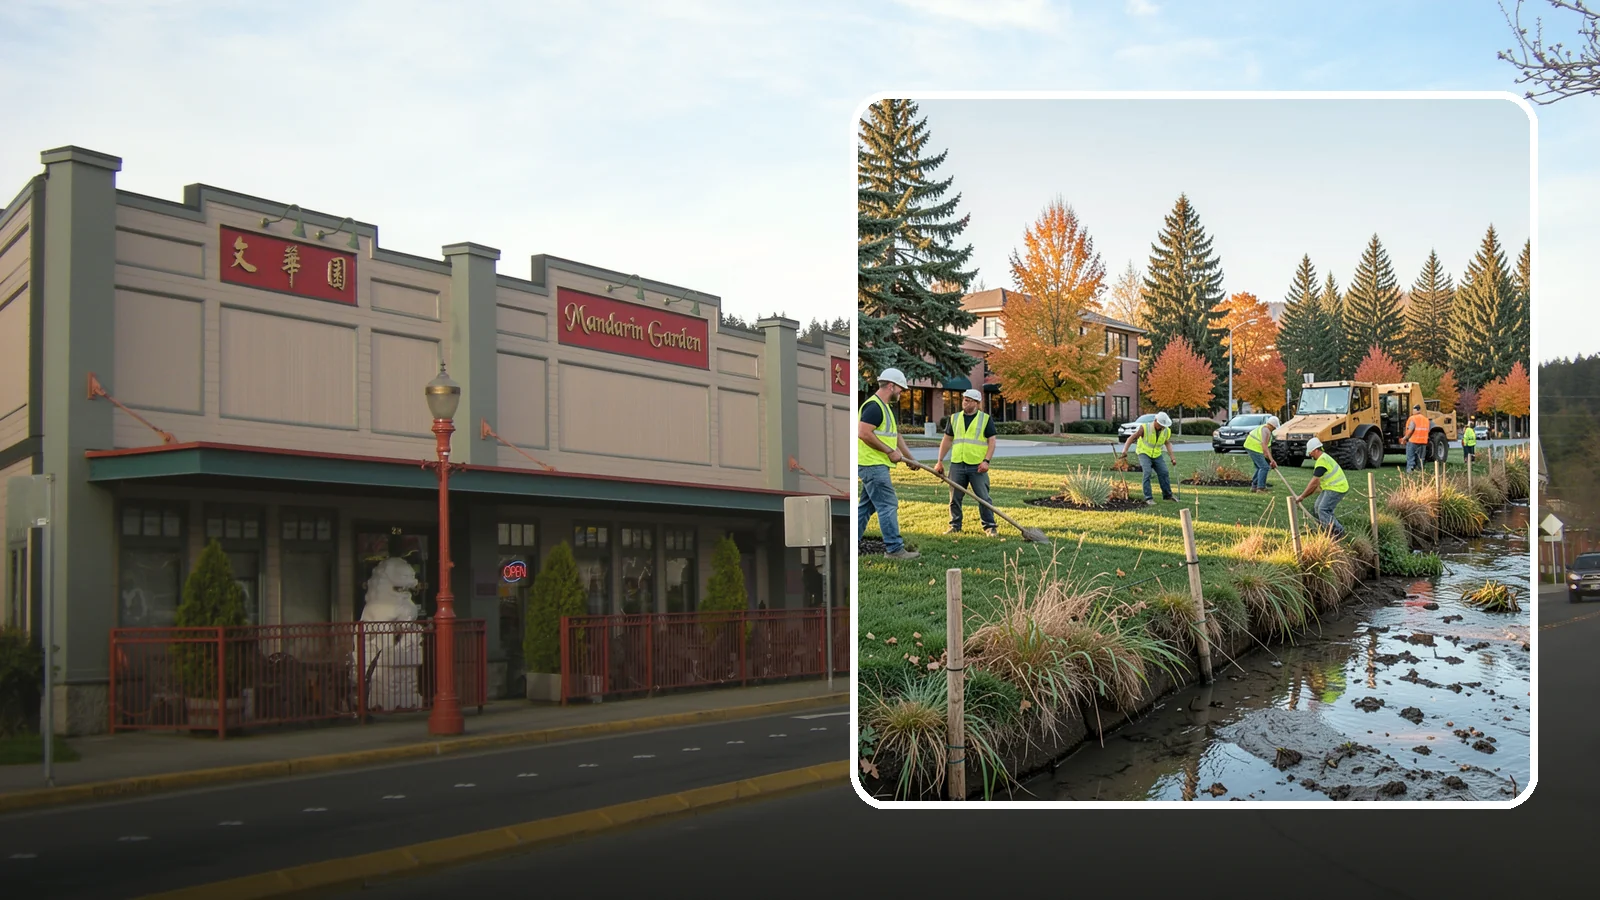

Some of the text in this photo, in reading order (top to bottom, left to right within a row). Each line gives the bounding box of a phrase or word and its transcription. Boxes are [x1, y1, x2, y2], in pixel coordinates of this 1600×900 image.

[230, 235, 346, 290] 文華園
[564, 302, 701, 352] Mandarin Garden
[503, 565, 526, 578] OPEN
